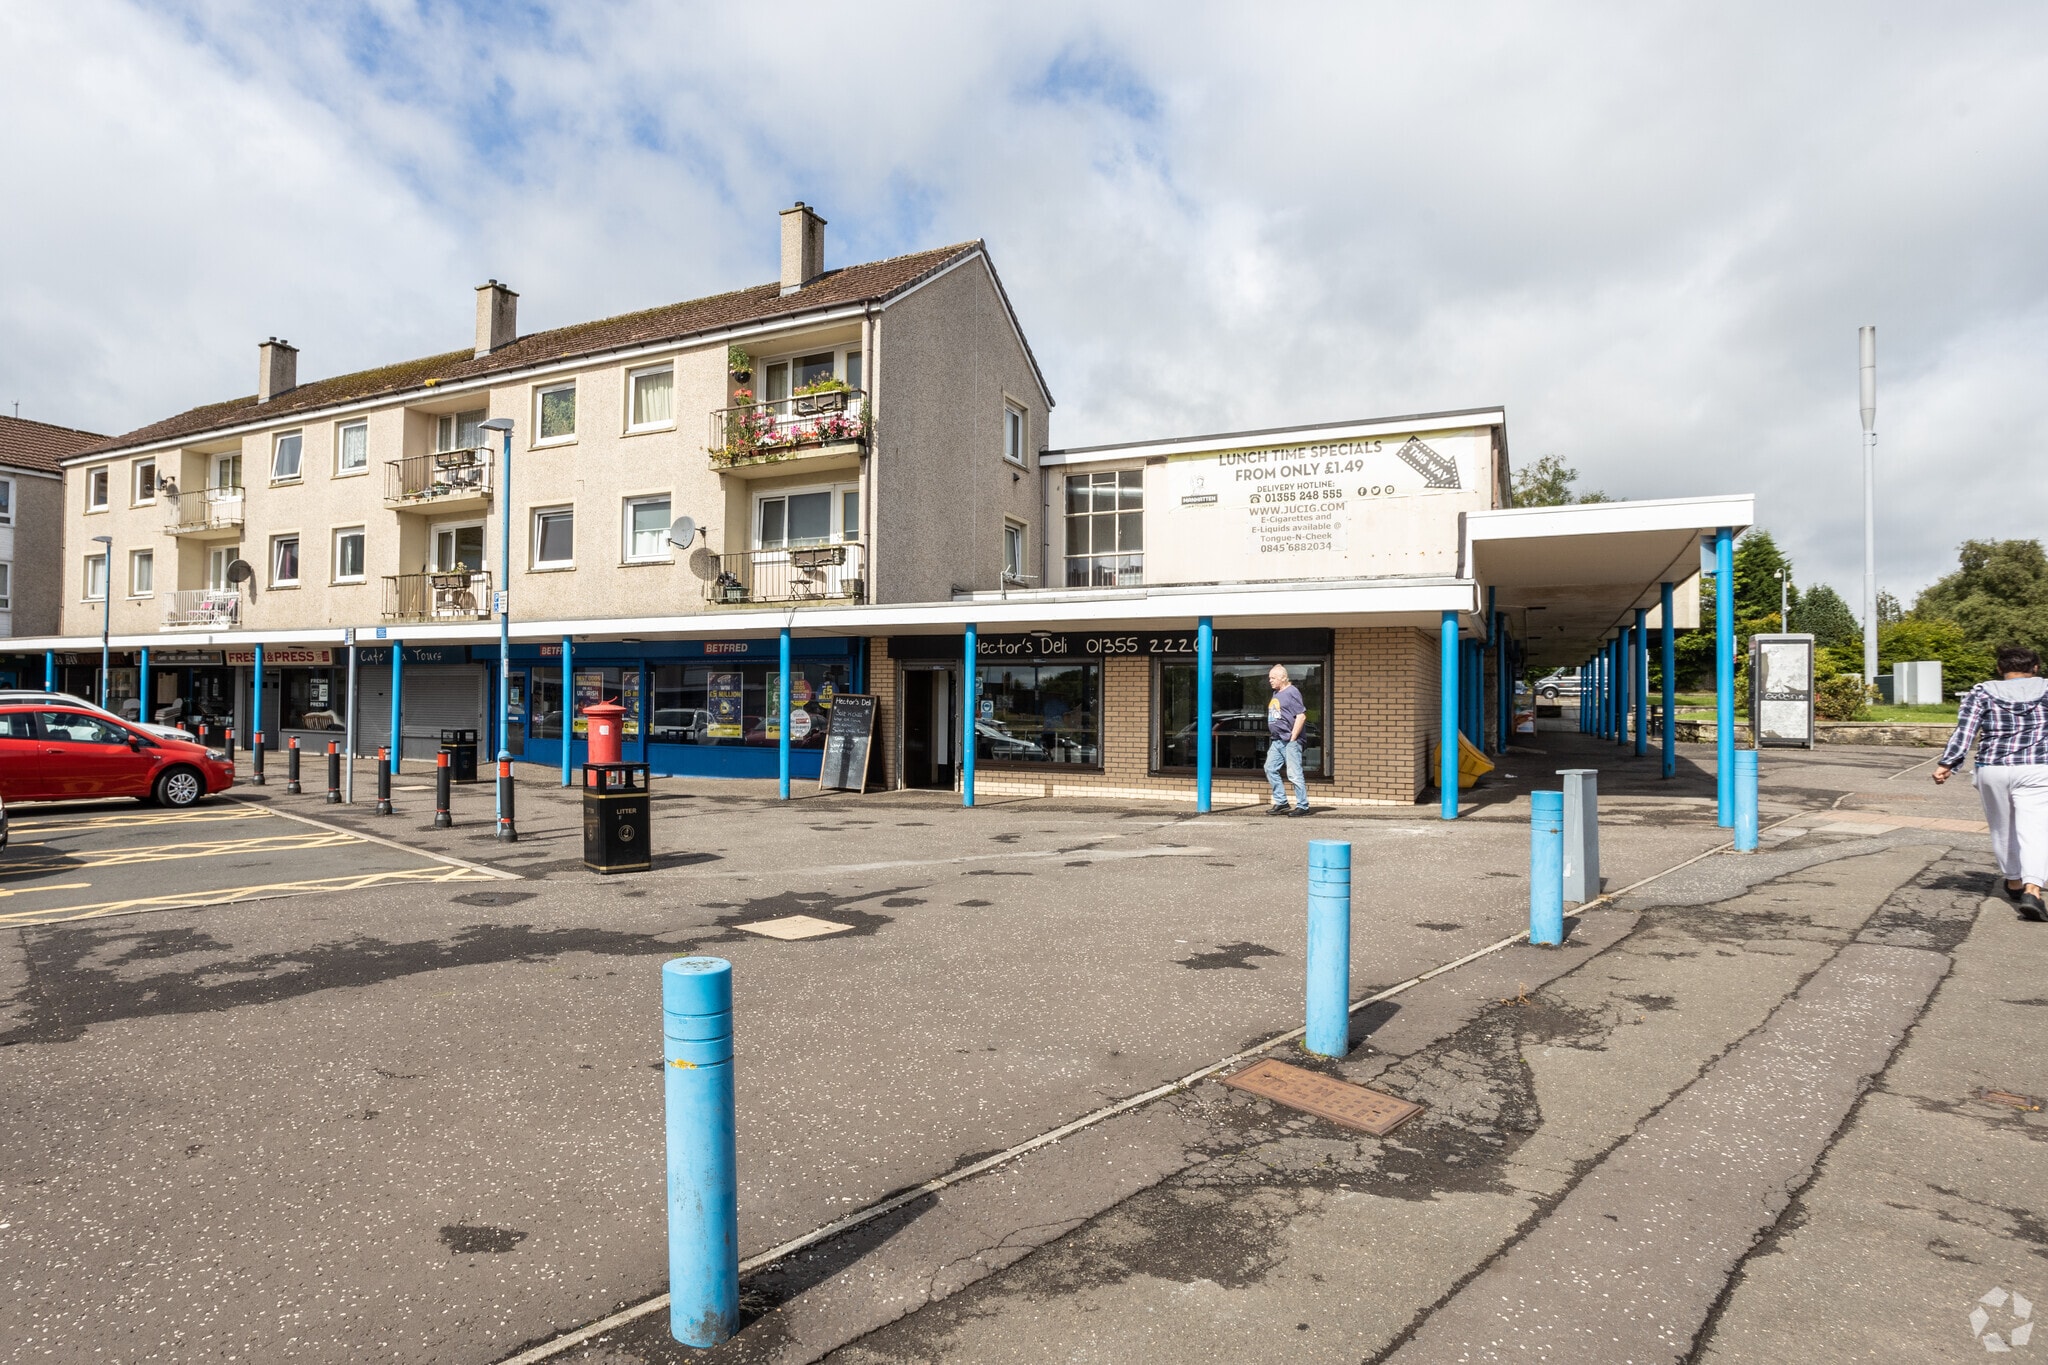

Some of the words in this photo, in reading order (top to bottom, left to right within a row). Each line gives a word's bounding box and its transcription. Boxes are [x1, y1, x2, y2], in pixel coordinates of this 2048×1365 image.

[1219, 450, 1267, 466] LUNCH
[1271, 447, 1306, 461] TIME
[1310, 440, 1383, 458] SPECIALS
[1409, 446, 1430, 465] THIS
[1427, 461, 1451, 480] WAY
[1235, 468, 1276, 481] FROM
[1280, 463, 1320, 478] ONLY
[1324, 459, 1364, 475] £1.49
[1257, 483, 1295, 493] DELIVERY
[1297, 480, 1335, 490] HOTLINE:
[1264, 492, 1296, 503] 01355
[1299, 490, 1320, 501] 248
[1322, 489, 1343, 499] 555
[1249, 502, 1345, 516] WWW.JUCIG.COM
[1261, 515, 1313, 524] E-Cigarettes
[1315, 513, 1332, 521] and
[1251, 525, 1290, 534] E-Liquids
[1292, 523, 1331, 532] available
[1260, 532, 1332, 543] Tongue-N-Cheek
[1260, 544, 1285, 553] 0845
[541, 646, 576, 656] BETFD
[706, 643, 748, 653] BETFRED
[1040, 637, 1068, 654] Deli
[1086, 637, 1138, 653] 01355
[413, 649, 442, 661] Tours
[616, 807, 637, 815] LITTER
